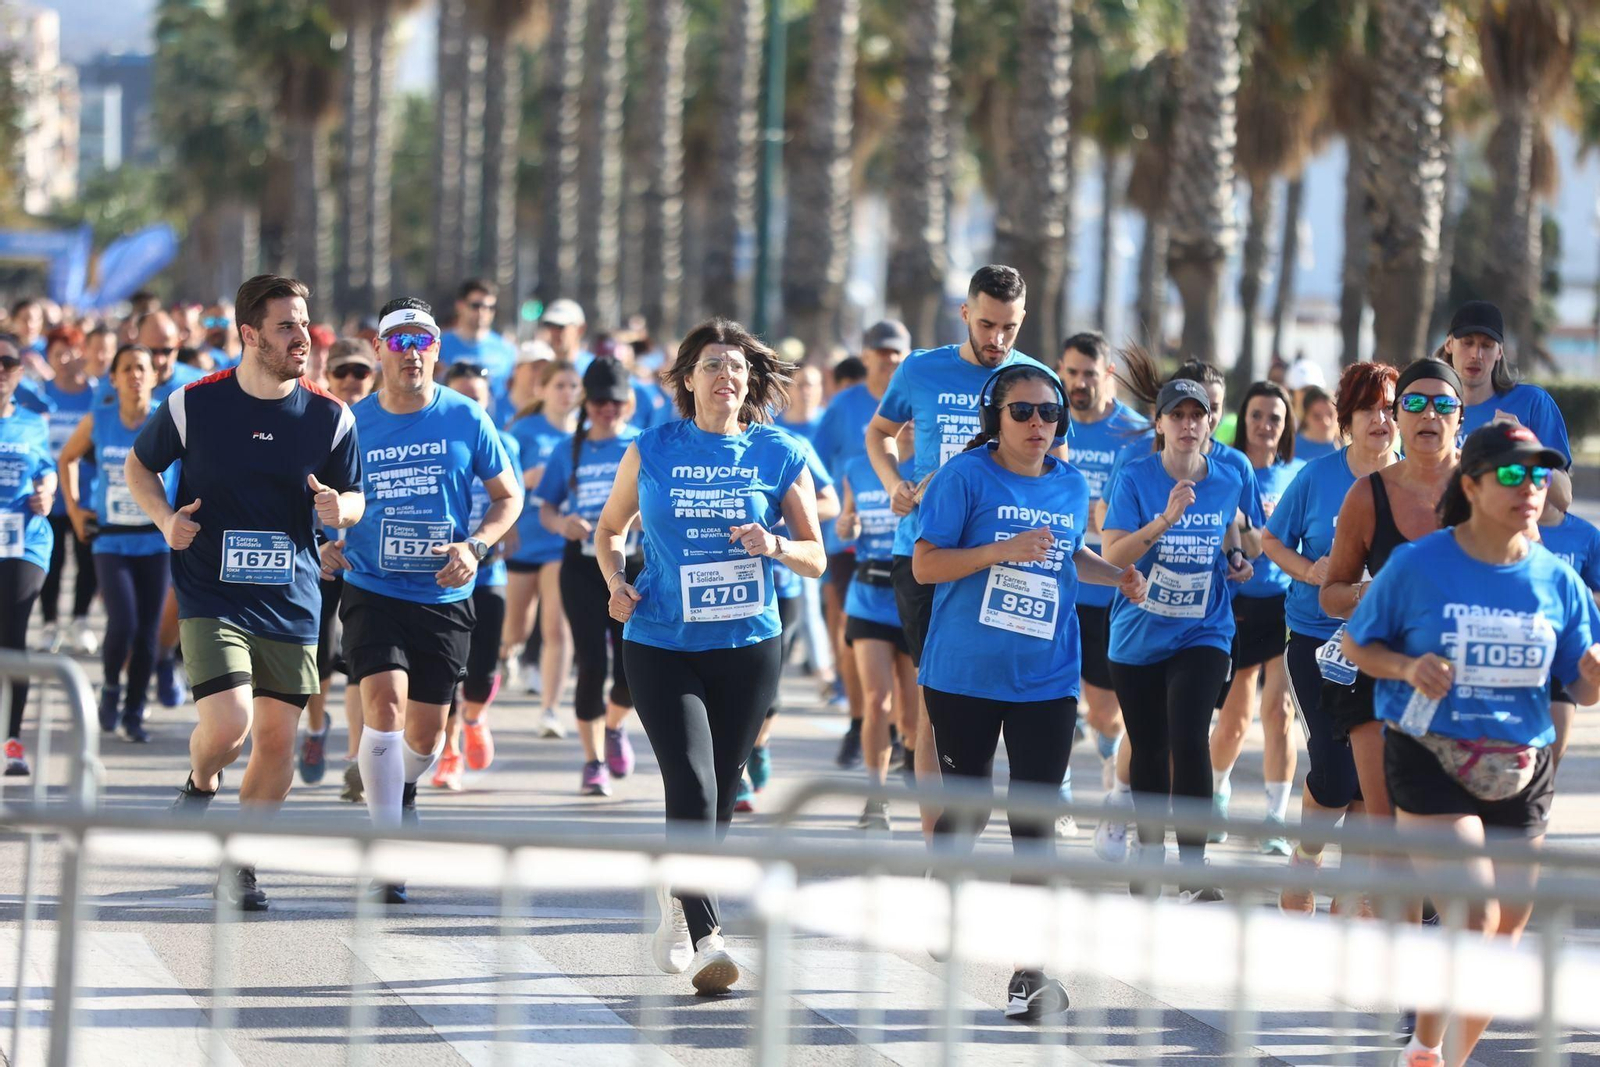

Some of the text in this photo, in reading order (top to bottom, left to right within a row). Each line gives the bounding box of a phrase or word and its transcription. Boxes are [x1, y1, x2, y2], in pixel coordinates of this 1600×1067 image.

[252, 431, 274, 441] FILA
[366, 439, 447, 463] mayoral
[367, 465, 443, 483] RUNNING
[672, 465, 759, 483] mayoral
[376, 475, 437, 491] MAKES
[376, 485, 439, 500] FRIENDS
[669, 487, 756, 500] RUNNING
[676, 498, 745, 508] MAKES
[674, 508, 747, 519] FRIENDS
[997, 505, 1074, 530] mayoral
[236, 536, 259, 544] Carrera
[1160, 545, 1215, 556] MAKES
[232, 551, 287, 567] 1675
[734, 562, 757, 571] mayoral
[1158, 555, 1214, 566] FRIENDS
[1002, 581, 1031, 593] Solidaria
[1003, 575, 1028, 586] Carrera
[701, 585, 748, 605] 470
[1157, 588, 1196, 606] 534
[1001, 593, 1047, 619] 939
[1471, 644, 1543, 668] 1059
